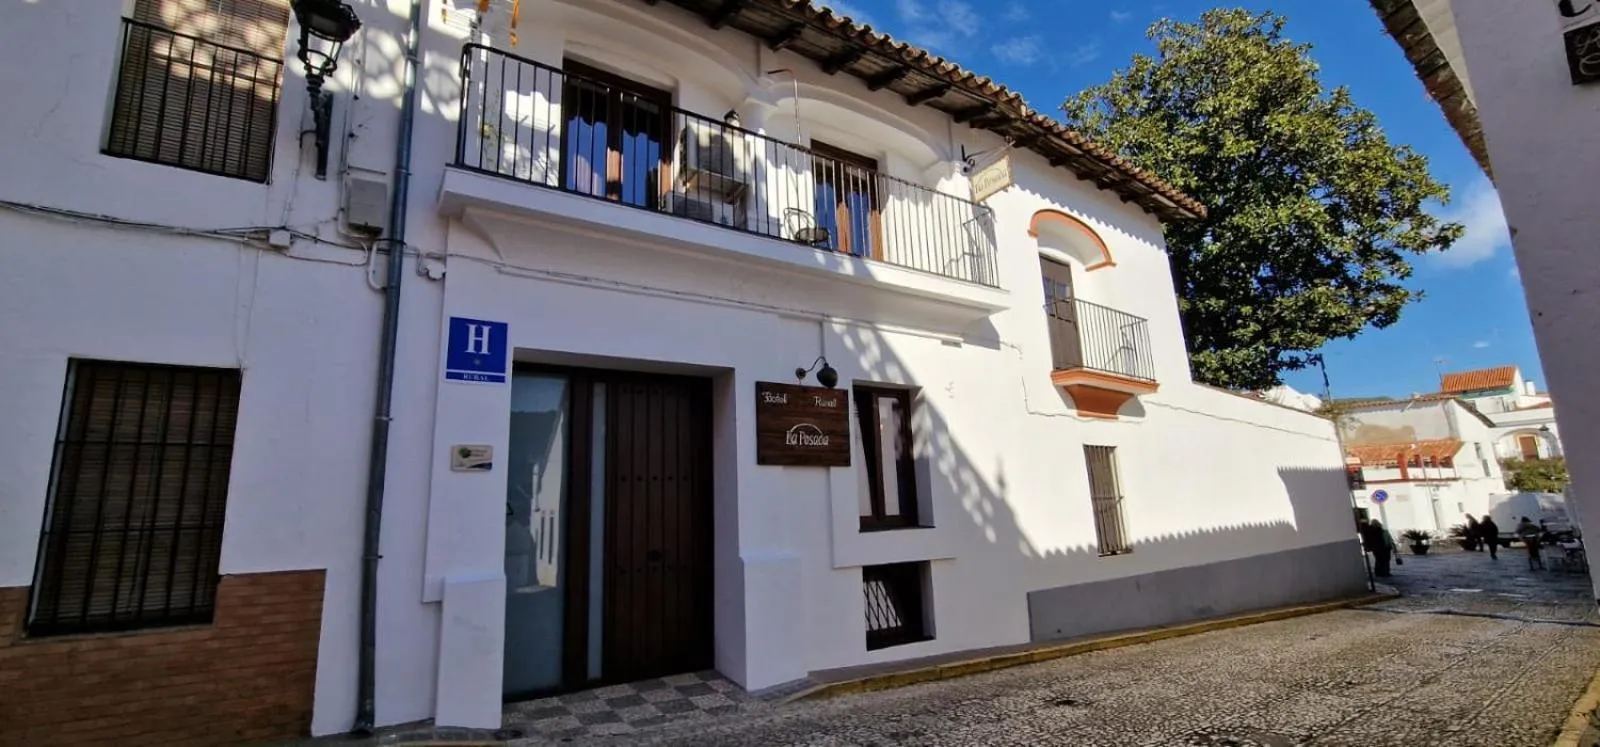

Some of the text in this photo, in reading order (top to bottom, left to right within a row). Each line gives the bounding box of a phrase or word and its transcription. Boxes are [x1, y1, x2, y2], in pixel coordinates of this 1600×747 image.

[465, 323, 492, 355] H
[813, 395, 837, 408] Rural
[786, 430, 829, 446] La Posada
